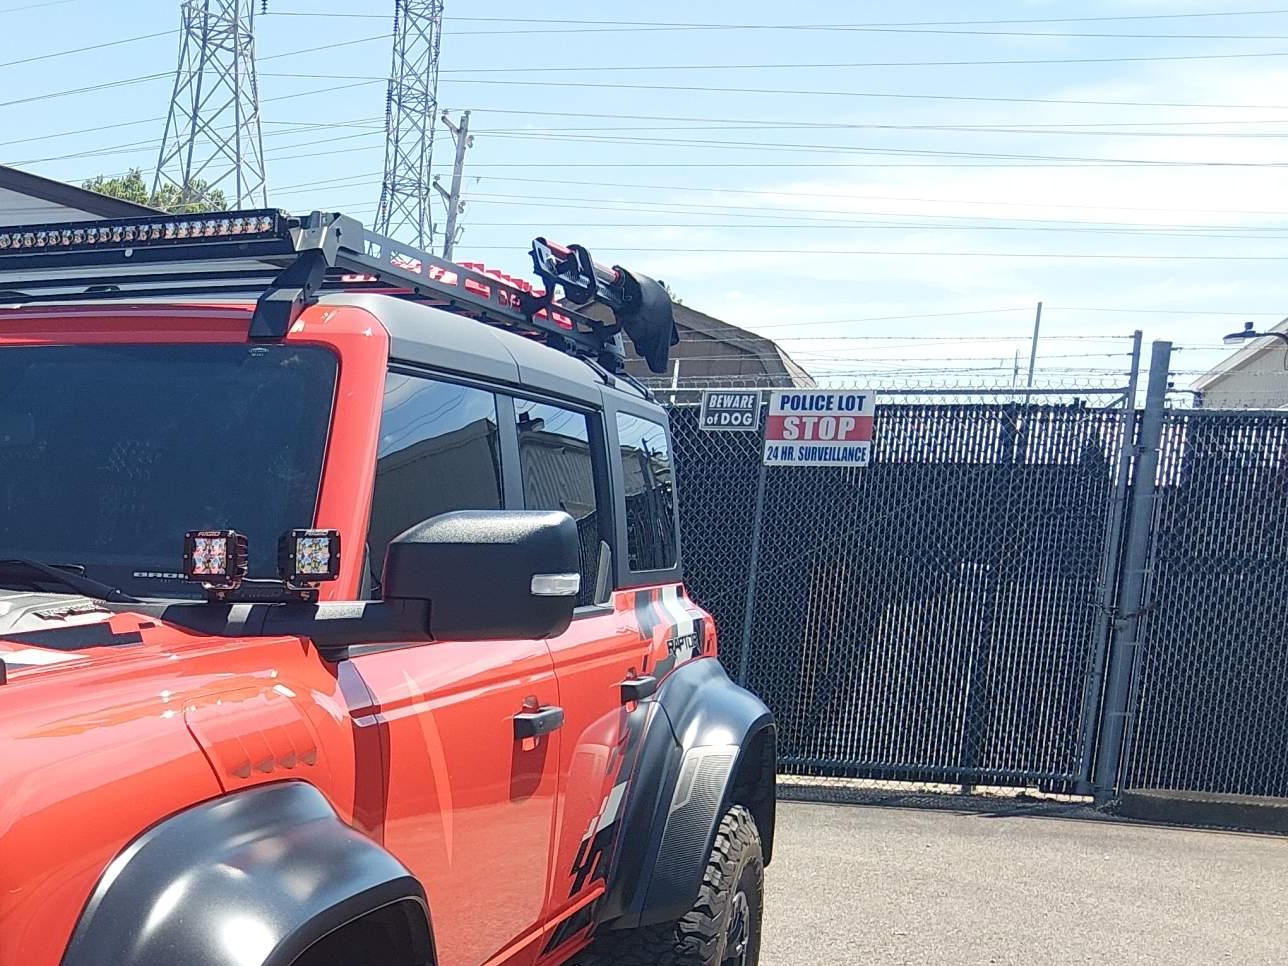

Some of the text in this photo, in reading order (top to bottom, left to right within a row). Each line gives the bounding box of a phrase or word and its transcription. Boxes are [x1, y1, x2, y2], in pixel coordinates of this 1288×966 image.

[708, 394, 755, 409] BEWARE
[780, 394, 866, 411] POLICE LOT
[706, 413, 753, 425] of DOG
[783, 416, 856, 440] STOP
[767, 445, 866, 462] 24 HR. SURVEILLANCE
[667, 633, 699, 655] RAPTOR
